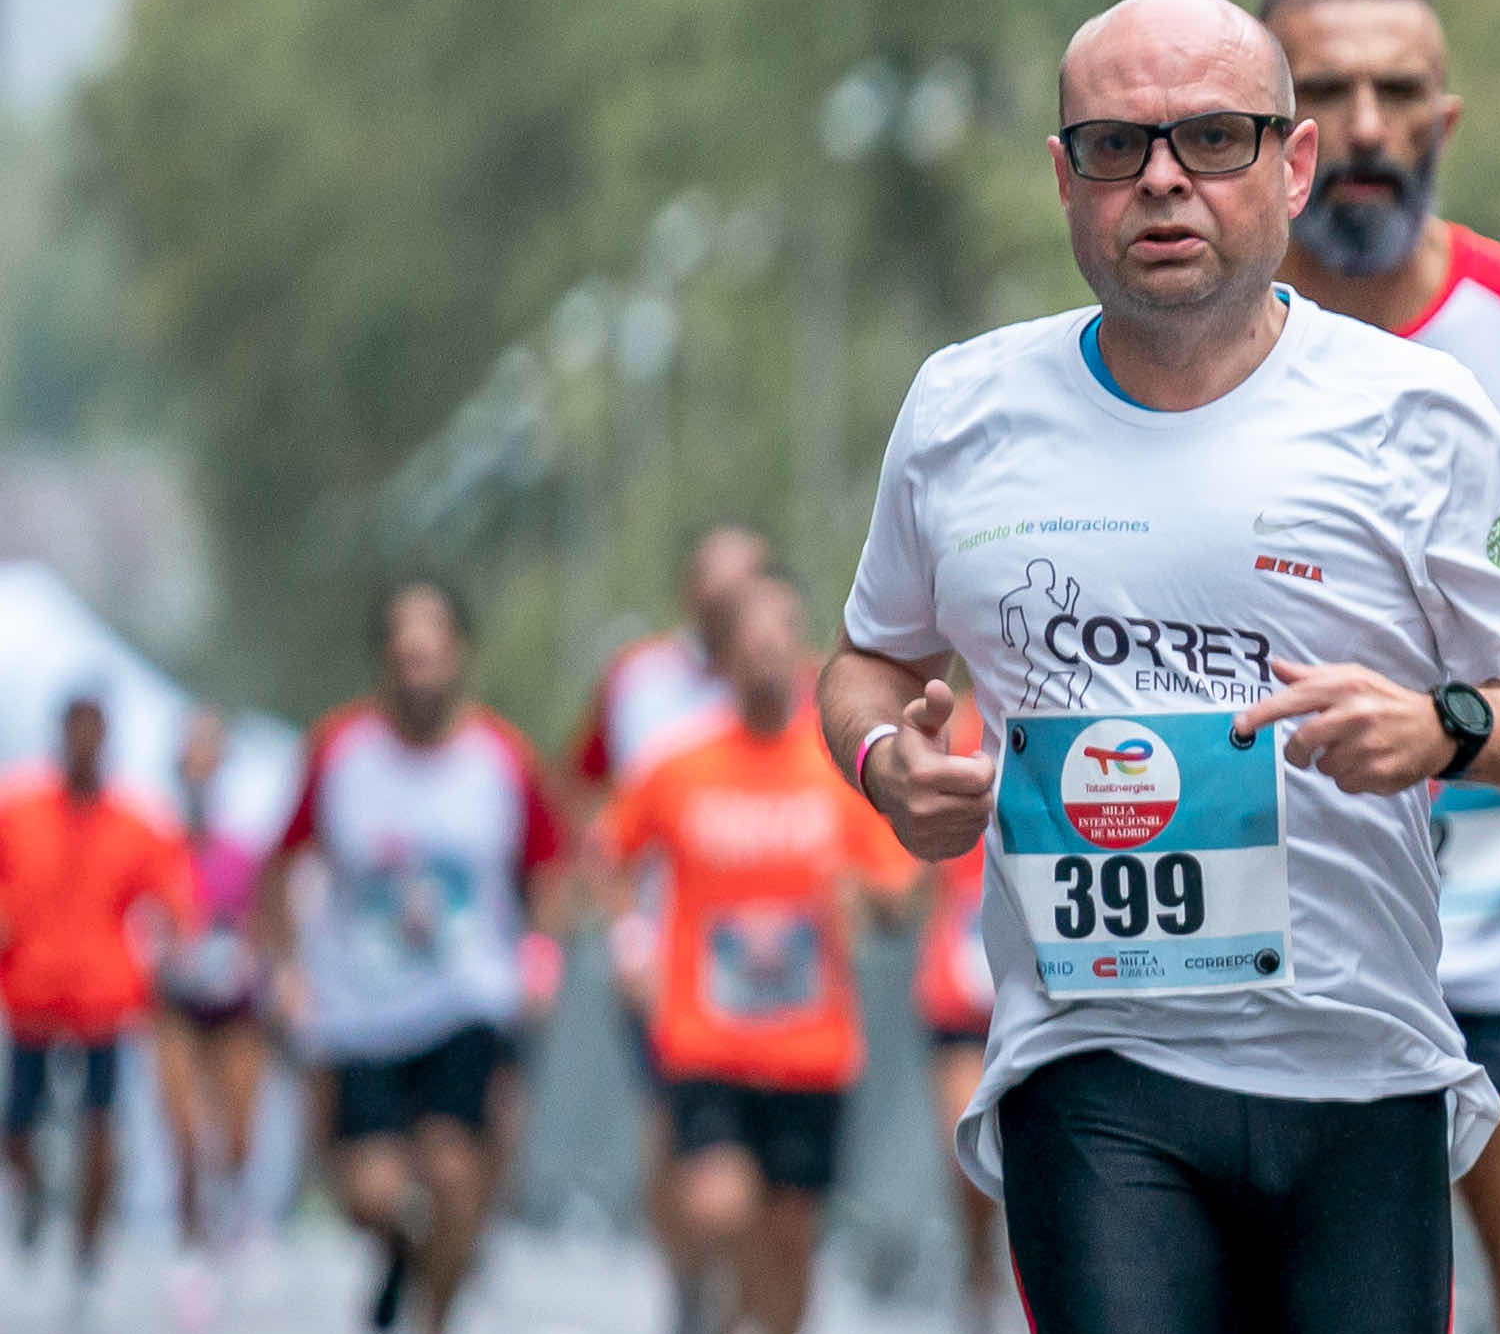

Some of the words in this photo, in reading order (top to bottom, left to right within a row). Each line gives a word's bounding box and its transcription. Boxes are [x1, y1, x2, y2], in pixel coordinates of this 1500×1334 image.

[957, 523, 1010, 554] instituto
[1015, 520, 1035, 536] de
[1039, 516, 1150, 533] valoraciones
[1044, 613, 1272, 682] CORRER
[1053, 852, 1206, 939] 399
[1119, 955, 1159, 967] MILLA
